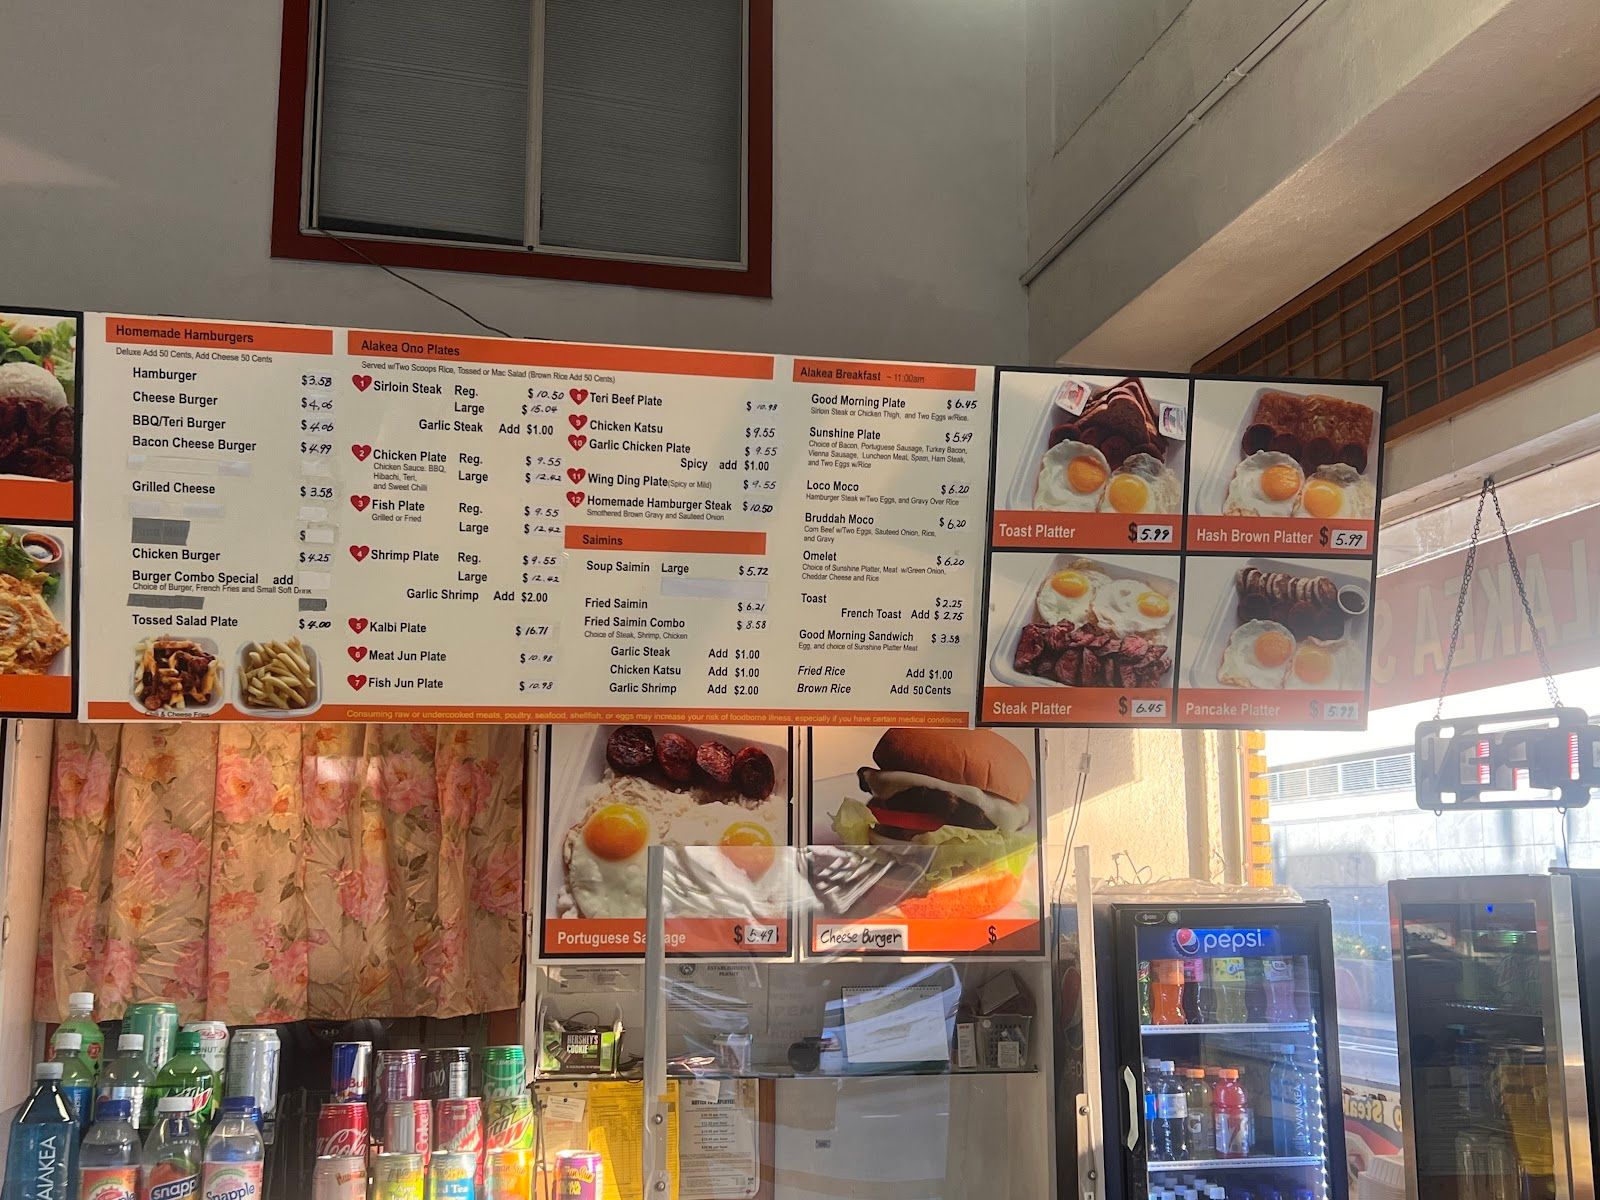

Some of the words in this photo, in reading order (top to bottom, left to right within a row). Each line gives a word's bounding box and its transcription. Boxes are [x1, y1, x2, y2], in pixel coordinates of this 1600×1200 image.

[116, 325, 181, 339] Homemade
[184, 329, 254, 344] Hamburgers
[362, 340, 398, 352] Alakea
[402, 343, 423, 354] Ono
[427, 344, 460, 356] Plates
[116, 347, 141, 356] Deluxe
[143, 349, 158, 357] Add
[211, 352, 239, 361] Cheese
[241, 354, 250, 362] 50
[252, 355, 272, 363] Cents
[133, 367, 197, 382] Hamburger
[800, 367, 833, 379] Alakea
[836, 369, 881, 381] Breakfast
[374, 381, 409, 392] Sirloin
[412, 382, 442, 394] Steak
[133, 392, 175, 403] Cheese
[179, 394, 218, 407] Burger
[590, 393, 609, 403] Teri
[612, 394, 635, 404] Beef
[638, 395, 662, 406] Plate
[812, 394, 837, 405] Good
[841, 396, 880, 408] Morning
[882, 397, 905, 408] Plate
[133, 415, 183, 427] BBQ/Teri
[188, 417, 226, 431] Burger
[419, 419, 451, 431] Garlic
[454, 421, 483, 433] Steak
[499, 424, 520, 434] Add
[527, 424, 554, 435] $1.00
[590, 420, 631, 432] Chicken
[634, 423, 663, 433] Katsu
[810, 427, 854, 438] Sunshine
[857, 430, 880, 439] Plate
[133, 436, 169, 447] Bacon
[172, 438, 215, 449] Cheese
[218, 439, 256, 453] Burger
[590, 439, 619, 450] Garlic
[623, 441, 663, 452] Chicken
[666, 443, 690, 453] Plate
[373, 449, 417, 461] Chicken
[420, 451, 447, 462] Plate
[681, 458, 708, 471] Spicy
[719, 460, 737, 469] add
[744, 461, 769, 471] $1.00
[588, 474, 614, 486] Wing
[617, 475, 640, 487] Ding
[643, 476, 668, 486] Plate
[807, 480, 830, 490] Loco
[833, 481, 859, 491] Moco
[133, 481, 170, 492] Grilled
[173, 482, 215, 494] Cheese
[372, 500, 395, 510] Fish
[399, 501, 425, 511] Plate
[588, 496, 644, 507] Homemade
[647, 498, 702, 510] Hamburger
[705, 500, 732, 511] Steak
[372, 514, 394, 522] Grilled
[805, 513, 846, 524] Bruddah
[848, 514, 874, 524] Moco
[999, 524, 1032, 539] Toast
[1035, 524, 1075, 539] Platter
[1197, 528, 1223, 542] Hash
[1226, 529, 1269, 544] Brown
[1272, 530, 1313, 545] Platter
[583, 535, 623, 546] Saimins
[132, 549, 178, 560] Chicken
[182, 550, 220, 563] Burger
[371, 550, 409, 562] Shrimp
[413, 551, 439, 561] Plate
[803, 551, 836, 561] Omelet
[587, 561, 613, 573] Soup
[616, 562, 650, 572] Saimin
[662, 563, 689, 575] Large
[132, 571, 171, 583] Burger
[174, 572, 215, 583] Combo
[218, 573, 259, 586] Special
[273, 575, 293, 585] add
[407, 589, 438, 599] Garlic
[441, 590, 479, 602] Shrimp
[494, 591, 515, 601] Add
[522, 592, 548, 603] $2.00
[801, 593, 826, 603] Toast
[585, 598, 611, 608] Fried
[614, 599, 648, 609] Saimin
[841, 608, 873, 618] French
[877, 609, 901, 619] Toast
[911, 610, 929, 619] Add
[132, 615, 172, 626] Tossed
[176, 616, 207, 626] Salad
[211, 616, 238, 627] Plate
[370, 622, 397, 632] Kalbi
[400, 623, 427, 633] Plate
[585, 617, 610, 627] Fried
[614, 617, 647, 627] Saimin
[650, 618, 685, 628] Combo
[800, 630, 825, 639] Good
[827, 630, 865, 642] Morning
[868, 631, 913, 641] Sandwich
[369, 650, 394, 661] Meat
[397, 651, 417, 661] Jun
[420, 652, 447, 662] Plate
[798, 666, 822, 675] Fried
[825, 666, 846, 676] Rice
[906, 669, 924, 678] Add
[929, 670, 953, 679] $1.00
[369, 678, 391, 688] Fish
[394, 678, 413, 688] Jun
[417, 678, 443, 689] Plate
[798, 684, 827, 693] Brown
[831, 684, 851, 694] Rice
[890, 685, 909, 694] Add
[913, 686, 923, 694] 50
[925, 685, 951, 695] Cents
[993, 701, 1029, 715] Steak
[1032, 701, 1071, 716] Platter
[1186, 703, 1237, 717] Pancake
[1240, 703, 1280, 717] Platter
[558, 932, 629, 946] Portuguese
[633, 931, 686, 946] Saage
[820, 929, 858, 945] Cheese
[863, 929, 902, 947] Burger
[1204, 929, 1262, 951] pepsi
[36, 1135, 57, 1200] AIAKEA
